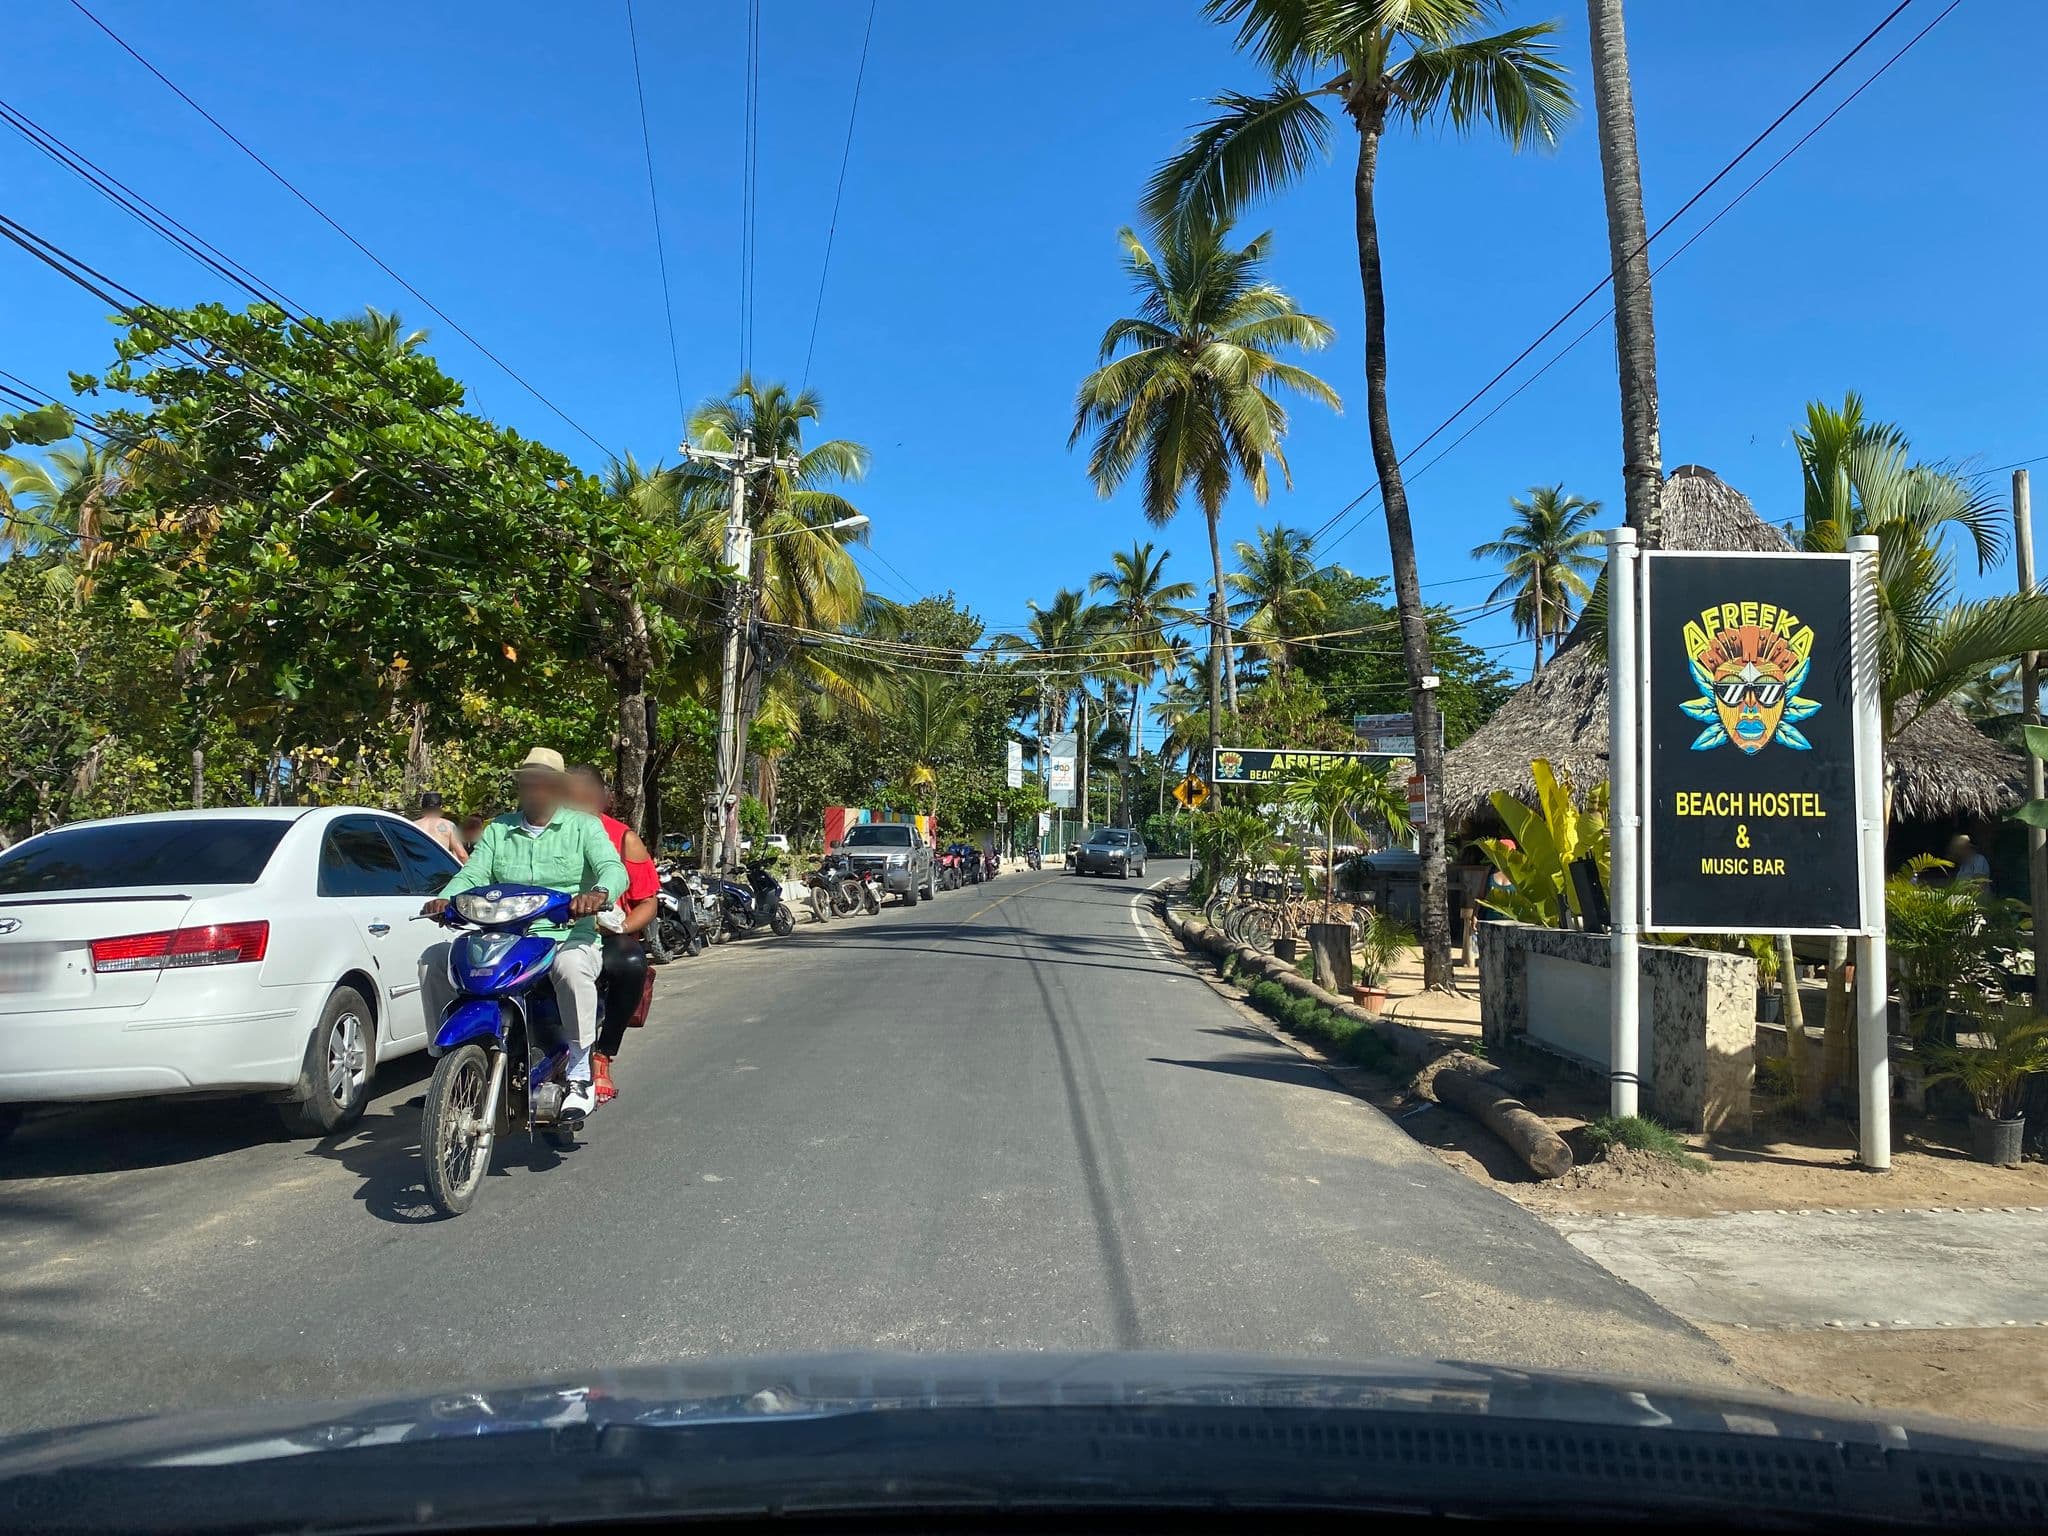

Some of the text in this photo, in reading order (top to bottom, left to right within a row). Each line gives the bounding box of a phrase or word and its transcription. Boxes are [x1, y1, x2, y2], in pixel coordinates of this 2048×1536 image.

[1683, 602, 1814, 661] AFREEKA
[1676, 792, 1826, 817] BEACH HOSTEL
[1736, 824, 1750, 849] &
[1701, 858, 1785, 875] MUSIC BAR
